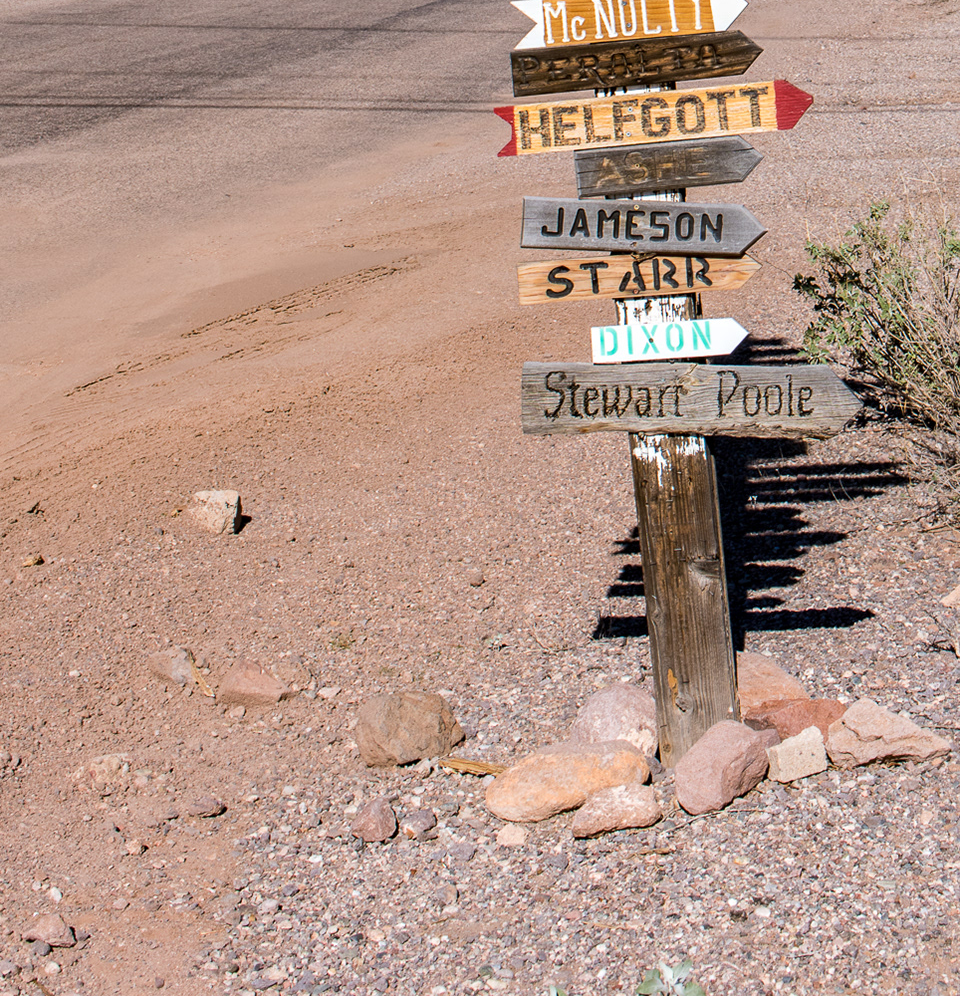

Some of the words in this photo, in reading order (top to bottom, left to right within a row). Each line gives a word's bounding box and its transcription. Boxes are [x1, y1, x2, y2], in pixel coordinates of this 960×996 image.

[518, 85, 769, 150] HELFGOTT
[541, 206, 724, 244] JAMESON
[545, 256, 714, 298] STARR
[599, 320, 713, 357] DIXON
[543, 369, 686, 422] Stewart
[715, 369, 816, 419] Poole
